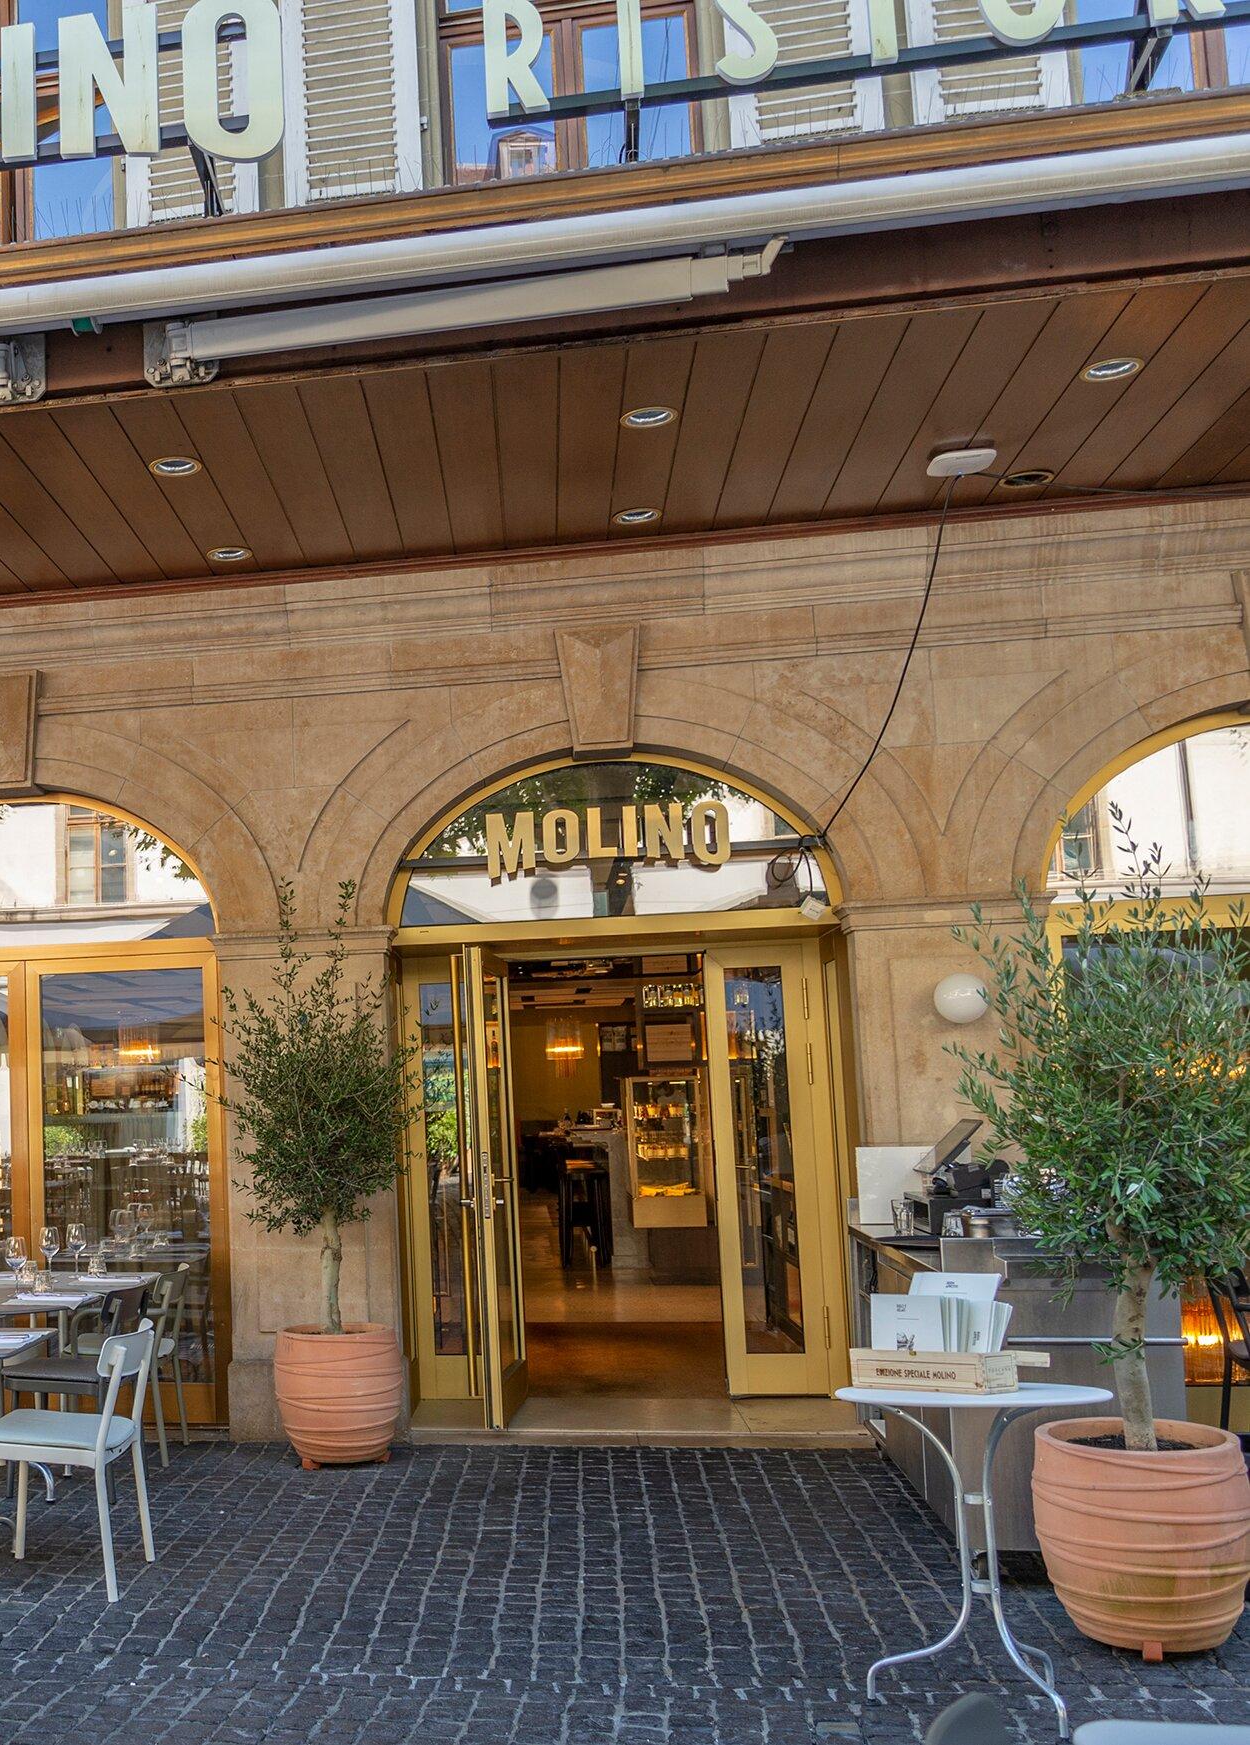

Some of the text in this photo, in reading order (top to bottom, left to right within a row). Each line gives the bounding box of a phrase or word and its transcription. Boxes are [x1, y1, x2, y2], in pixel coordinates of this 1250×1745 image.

[483, 0, 1226, 120] RIS
[484, 800, 732, 887] MOLINO
[903, 1369, 930, 1379] SPECIALE
[932, 1371, 956, 1380] MOLINO
